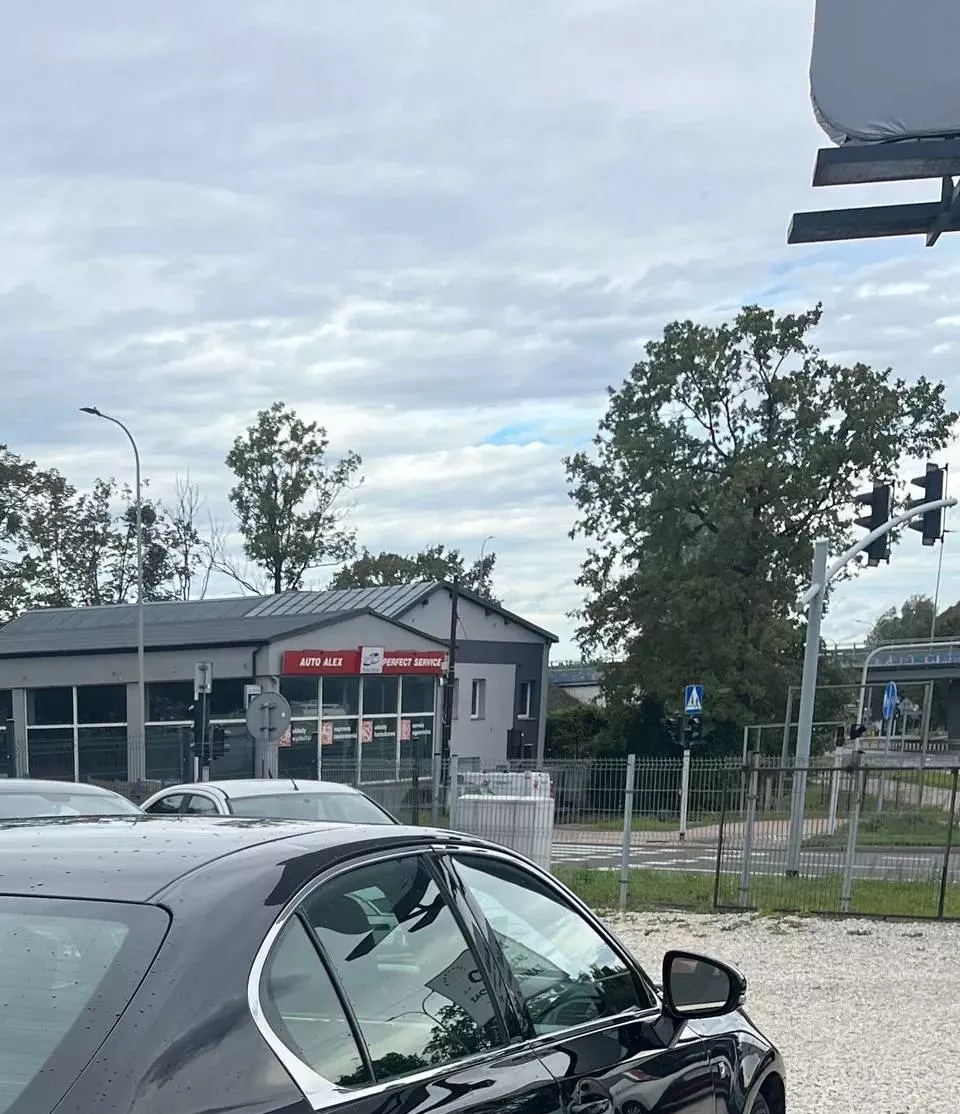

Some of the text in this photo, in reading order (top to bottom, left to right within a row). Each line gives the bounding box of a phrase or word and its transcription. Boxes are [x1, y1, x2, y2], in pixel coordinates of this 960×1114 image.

[299, 657, 344, 667] AUTO ALEX
[382, 657, 442, 667] PERFECT SERVICE
